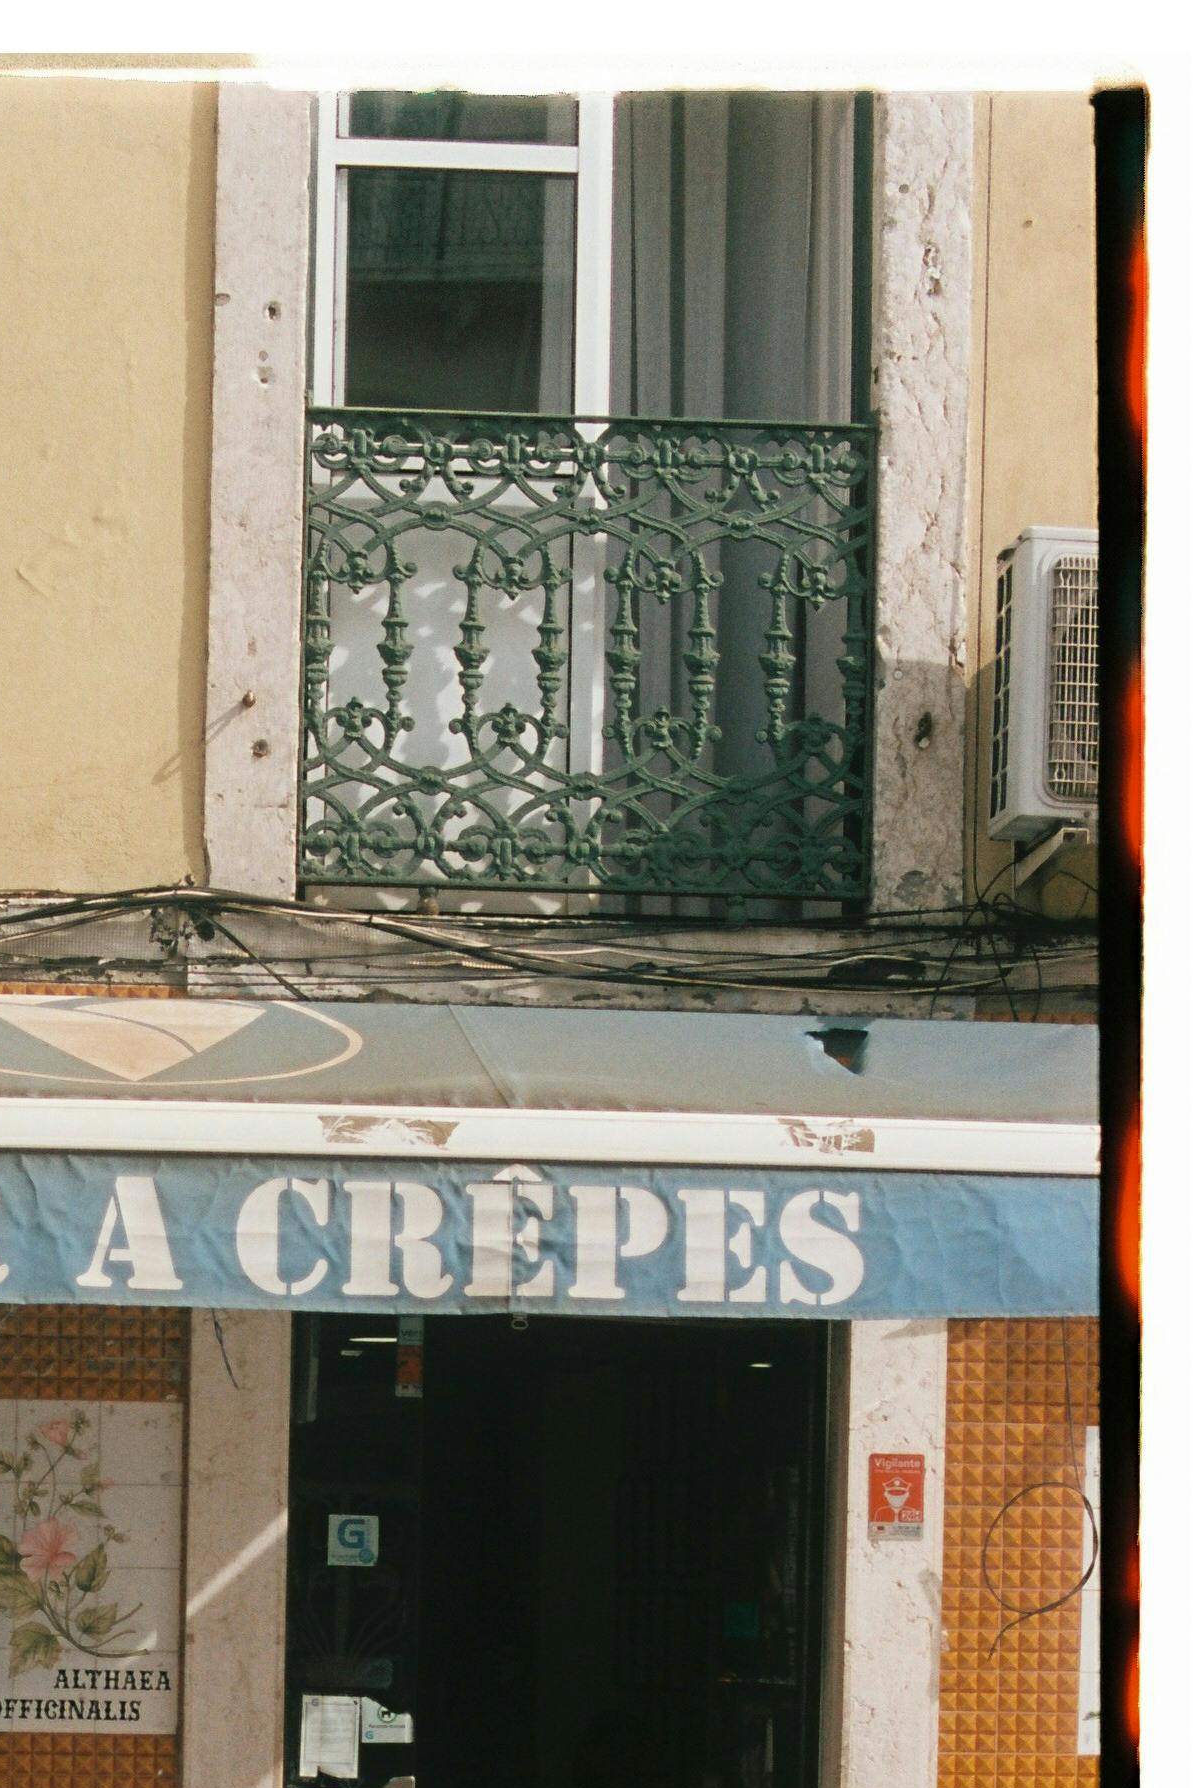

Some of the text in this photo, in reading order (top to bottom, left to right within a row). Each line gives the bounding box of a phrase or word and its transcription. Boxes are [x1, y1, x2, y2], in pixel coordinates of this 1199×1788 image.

[75, 1175, 184, 1291] A
[235, 1163, 866, 1307] CRÊPES
[337, 1518, 365, 1549] G
[54, 1669, 171, 1691] ALTHAEA
